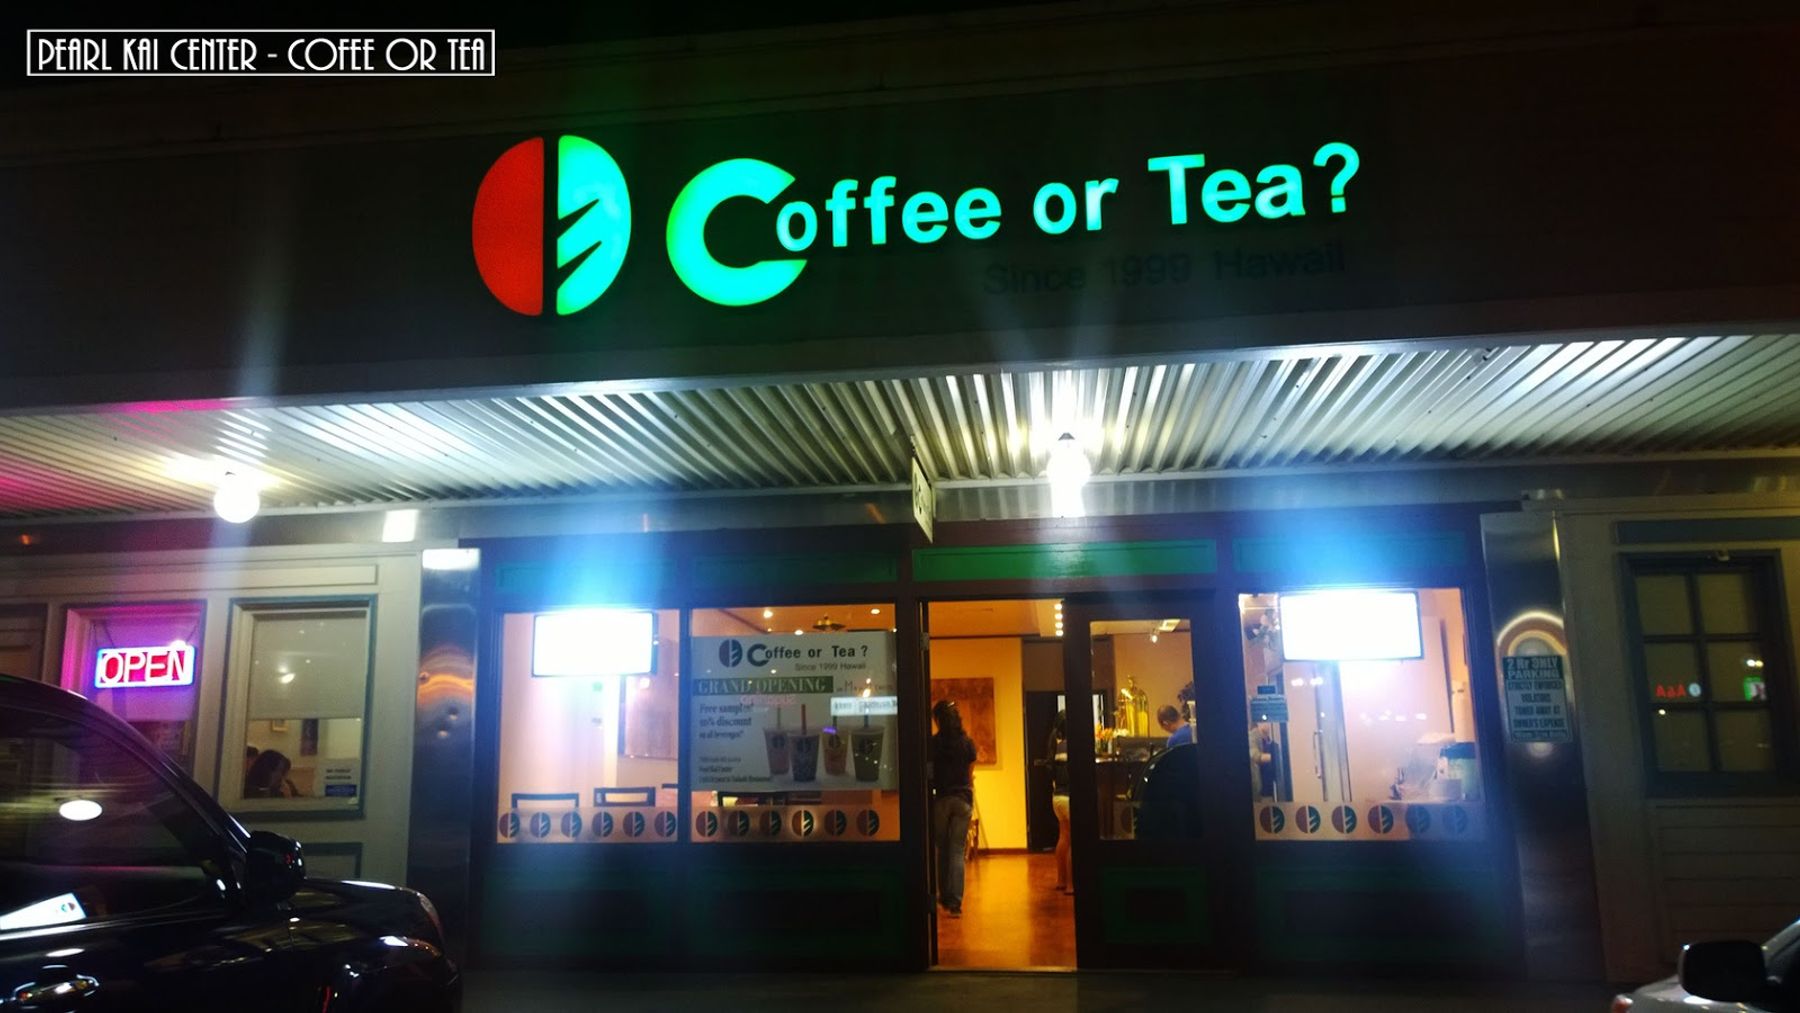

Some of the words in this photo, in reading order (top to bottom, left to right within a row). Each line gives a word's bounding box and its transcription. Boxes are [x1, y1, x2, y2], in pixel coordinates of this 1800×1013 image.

[666, 158, 1002, 306] Coffee
[1033, 177, 1119, 234] or
[1148, 141, 1360, 224] Tea?
[984, 262, 1086, 295] Since
[1101, 252, 1192, 288] 1999
[1214, 241, 1346, 281] Hawaii
[747, 643, 801, 667] Coffee
[808, 647, 822, 658] or
[831, 645, 856, 658] Tea
[1507, 658, 1514, 669] 2
[1532, 657, 1559, 669] ONLY
[100, 650, 186, 685] OPEN
[795, 663, 817, 672] Since
[819, 662, 837, 671] 1999
[841, 662, 866, 671] Hawaii
[1508, 669, 1560, 680] PARKING
[698, 679, 752, 695] GRAND
[755, 678, 826, 693] OPENING
[717, 715, 752, 727] discount
